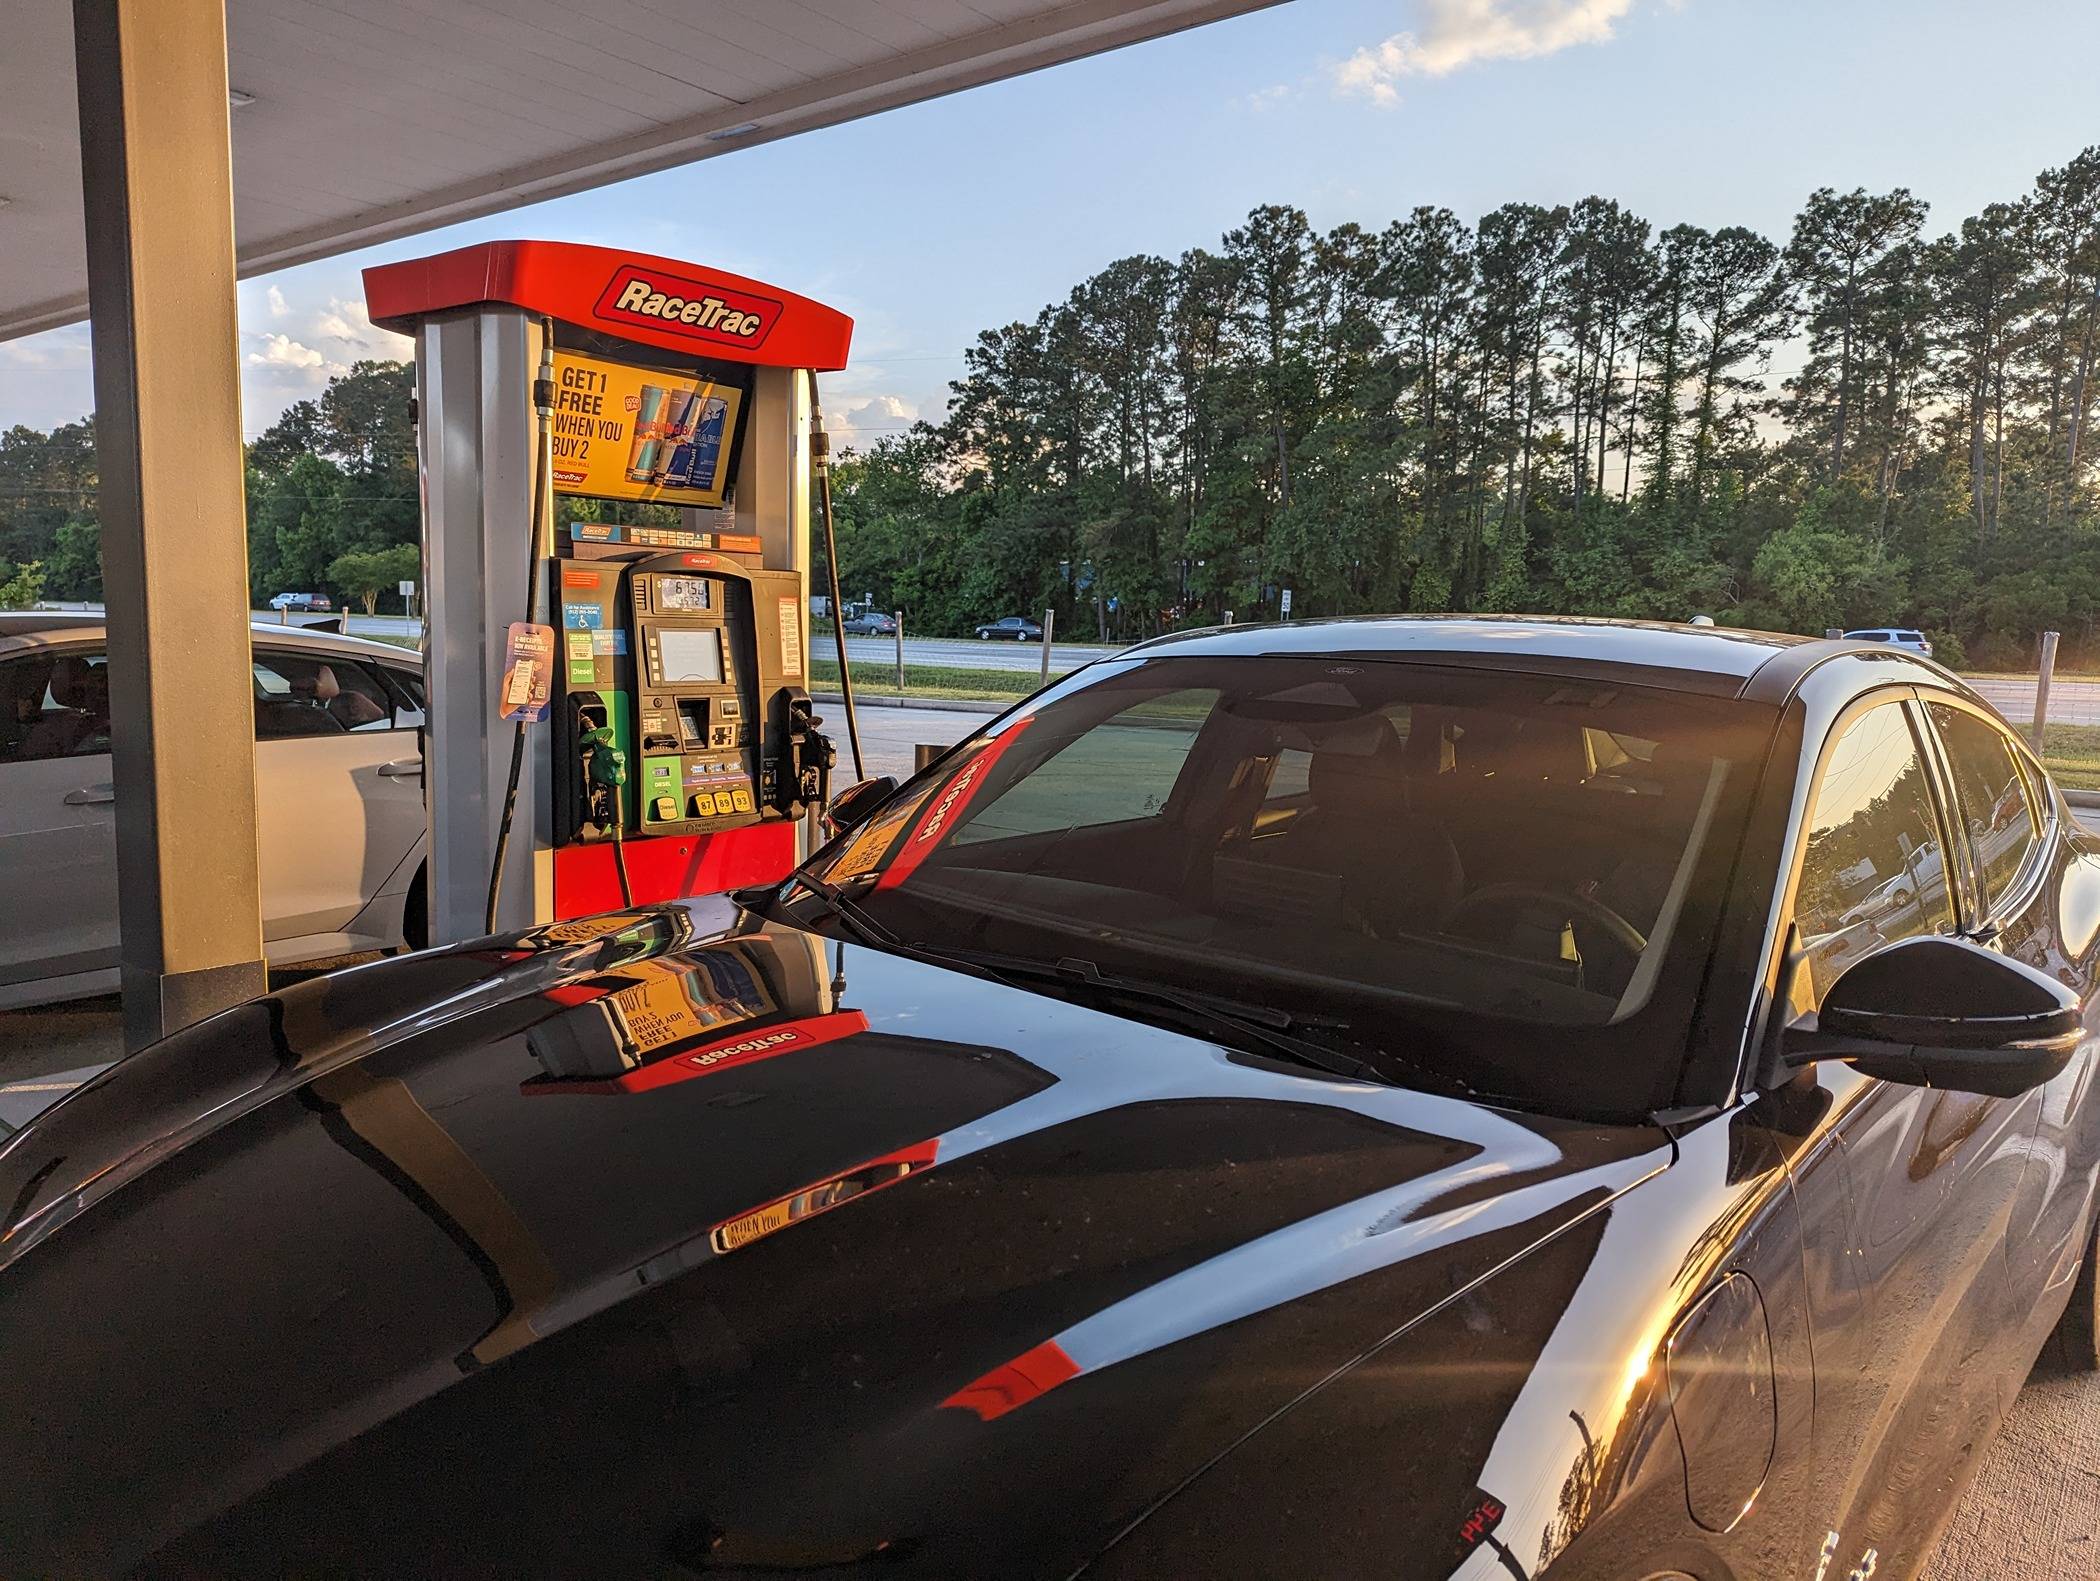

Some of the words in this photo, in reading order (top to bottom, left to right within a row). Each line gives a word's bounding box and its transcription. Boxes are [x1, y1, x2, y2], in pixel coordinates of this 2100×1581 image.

[615, 279, 761, 337] RaceTrac
[562, 366, 597, 391] GET
[600, 373, 607, 394] 1
[558, 389, 603, 415] FREE
[555, 412, 595, 437] WHEN
[598, 420, 623, 442] YOU
[552, 436, 579, 458] BUY
[579, 440, 589, 460] 2
[572, 667, 592, 676] Diesel
[700, 801, 711, 810] 87
[719, 799, 730, 808] 89
[736, 797, 748, 806] 93
